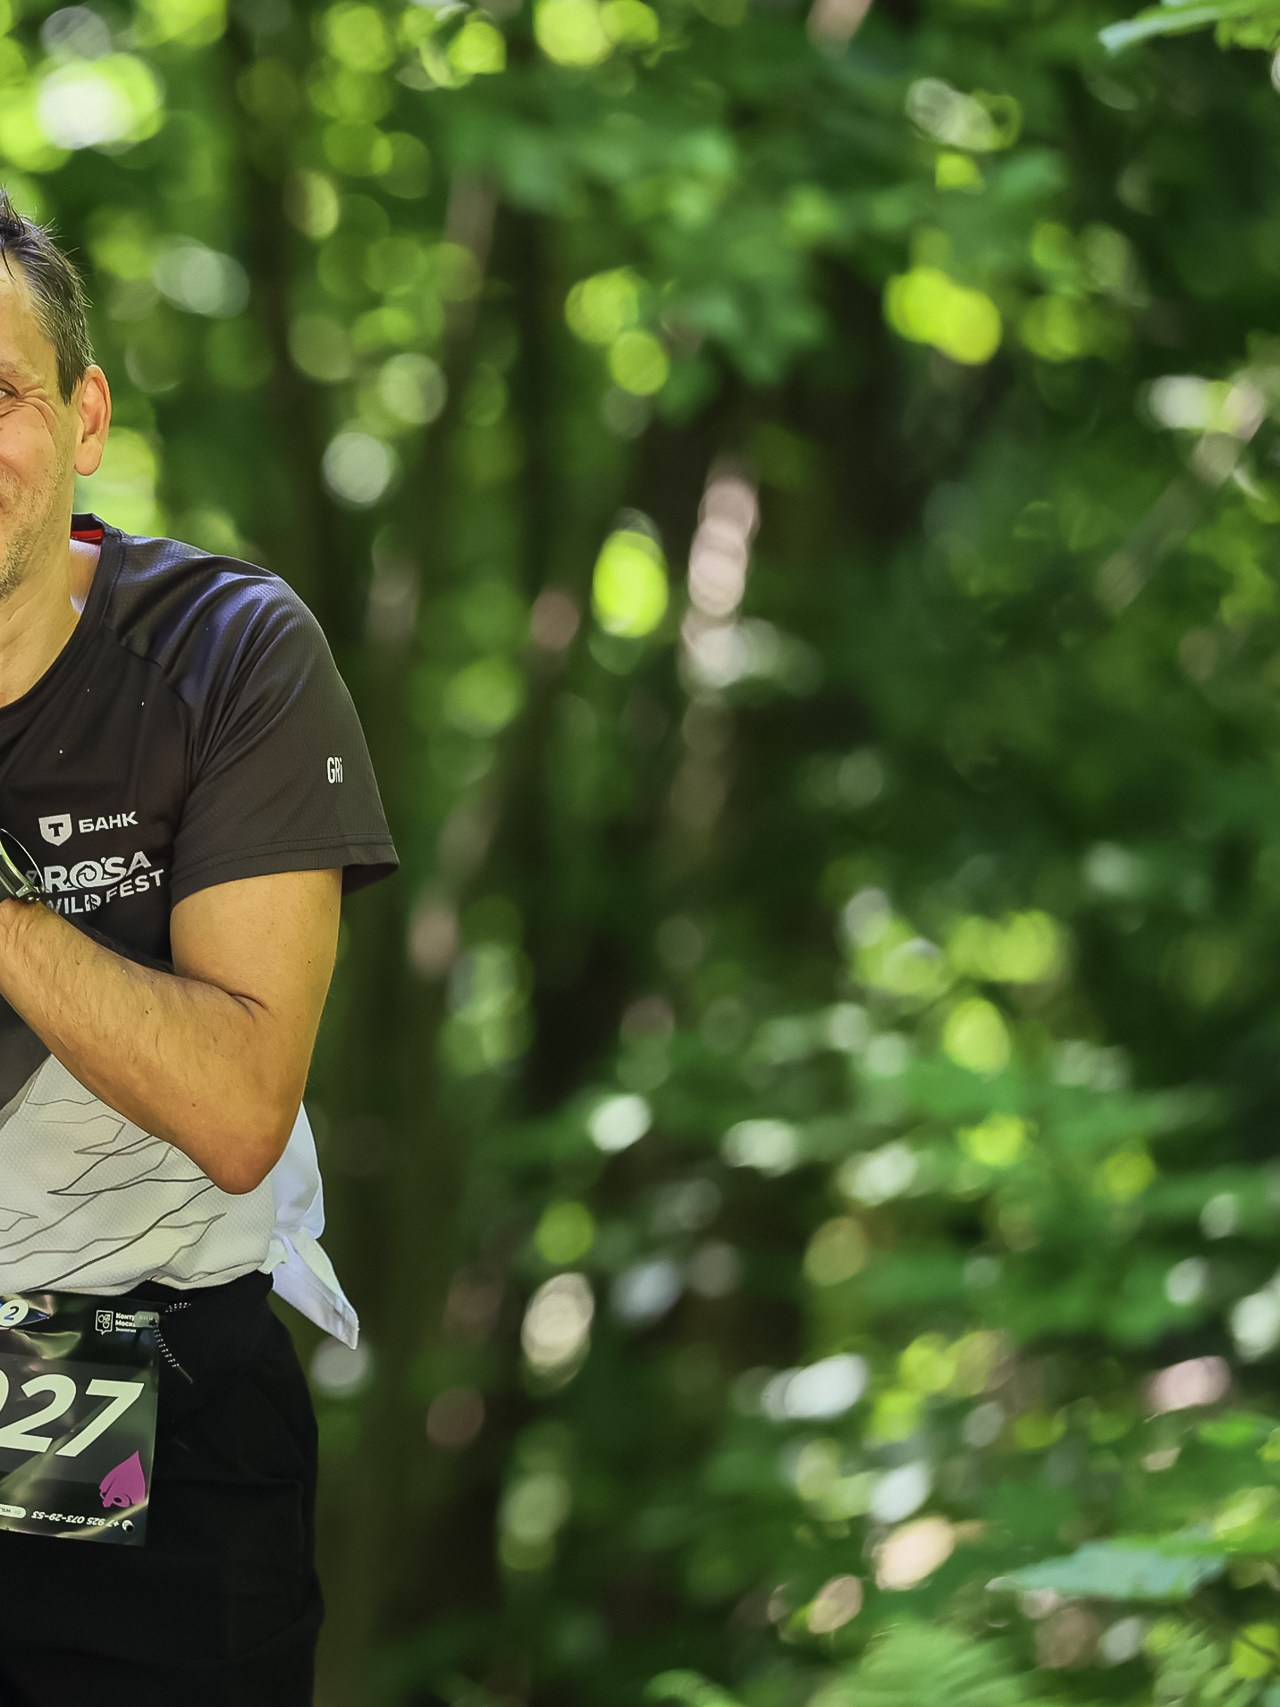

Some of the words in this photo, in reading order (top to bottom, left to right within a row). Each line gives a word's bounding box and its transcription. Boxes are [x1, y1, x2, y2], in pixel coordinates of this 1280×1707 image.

[78, 811, 139, 834] БАНК
[105, 868, 165, 903] FEST
[4, 1305, 20, 1321] 2
[86, 1517, 106, 1526] 925
